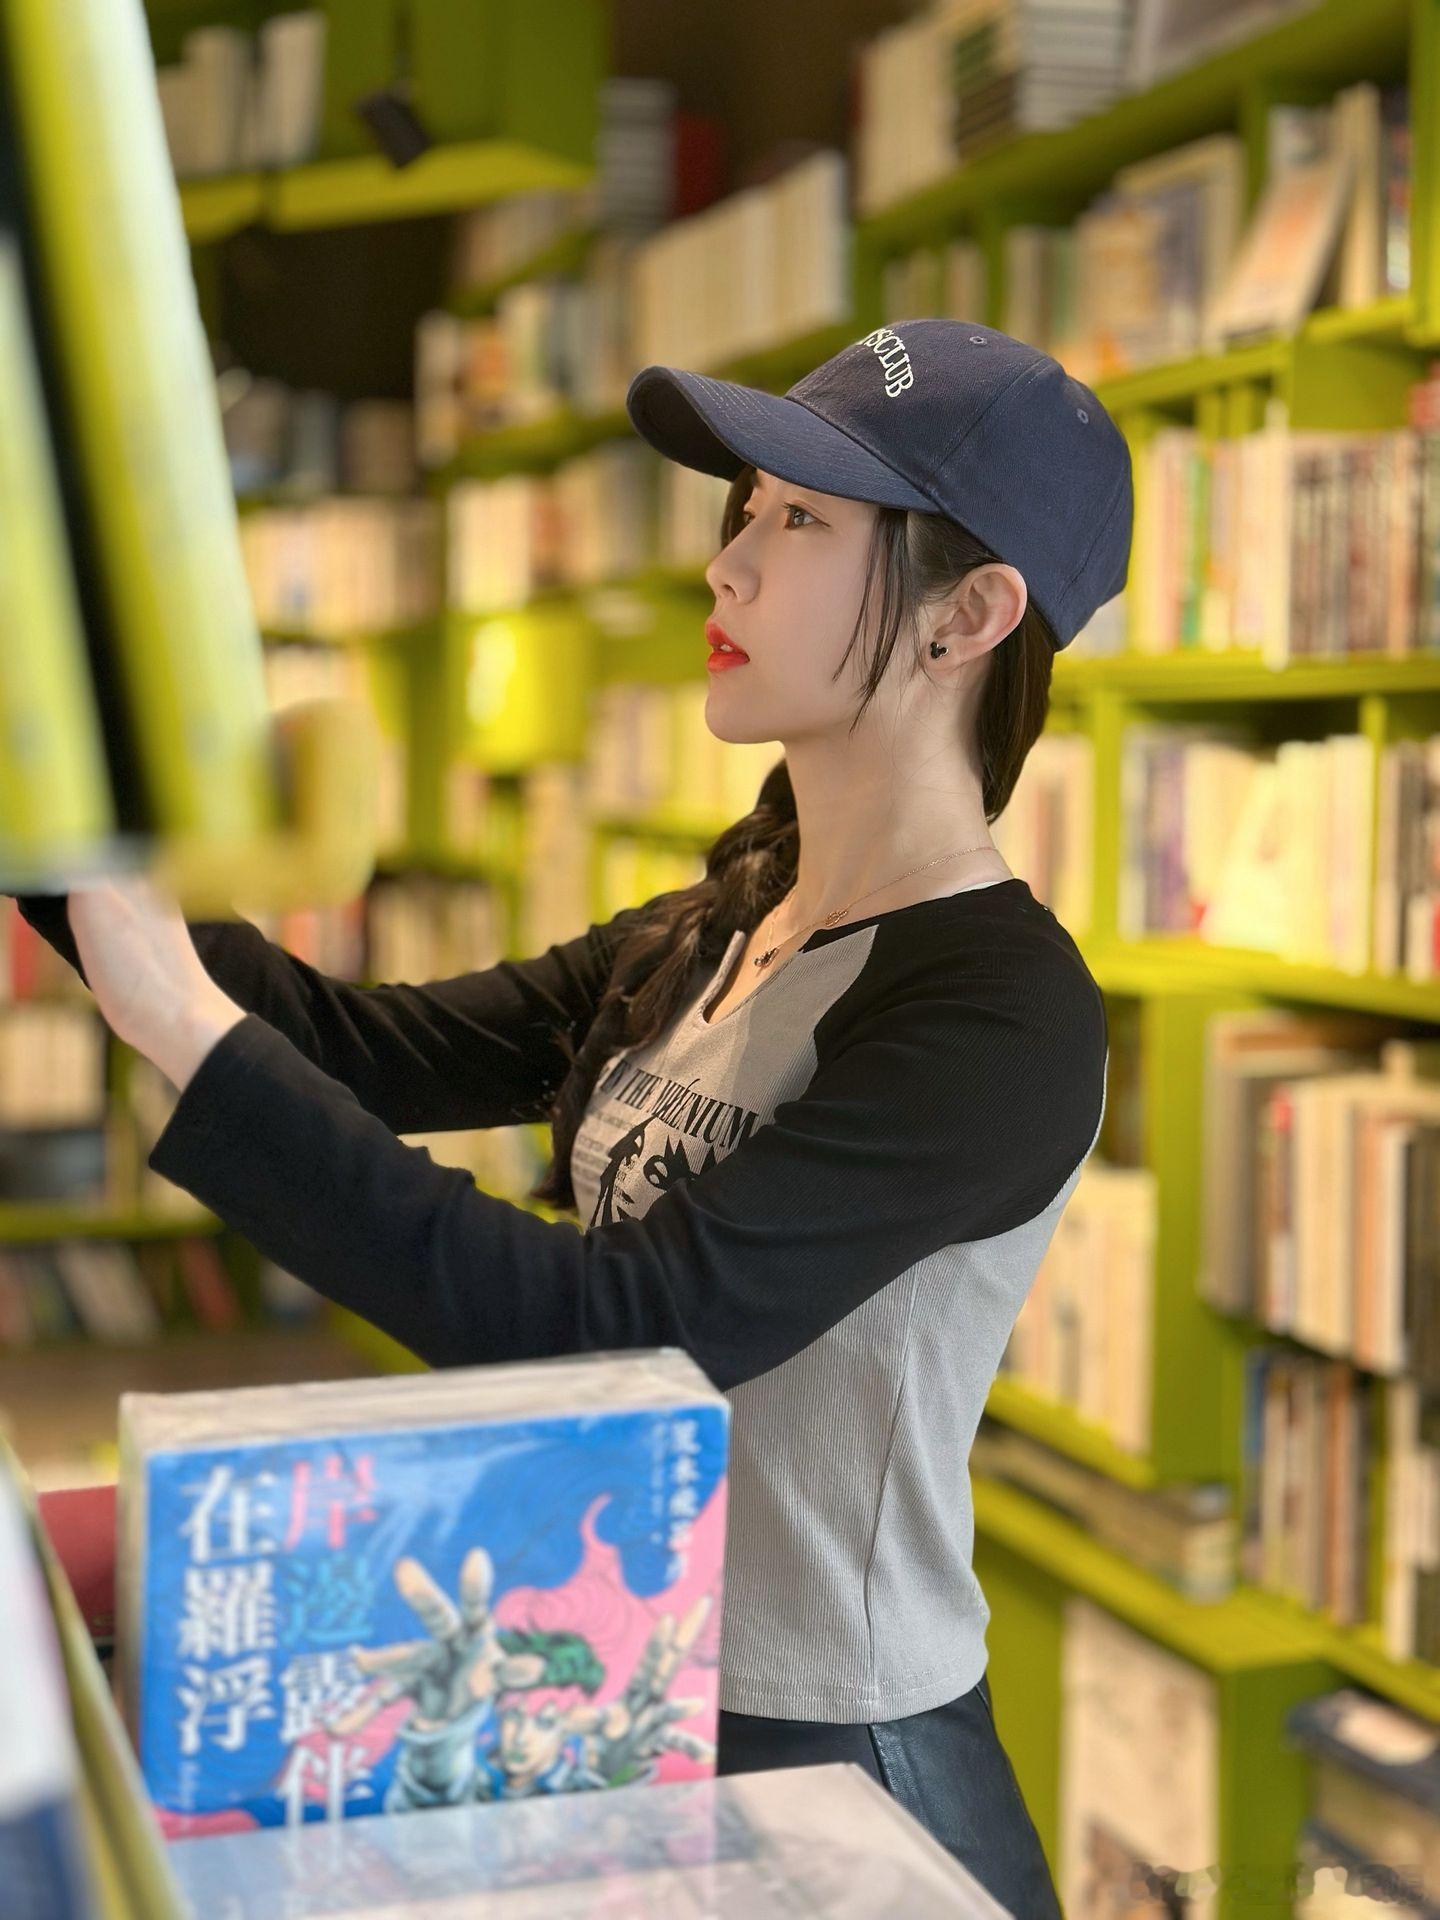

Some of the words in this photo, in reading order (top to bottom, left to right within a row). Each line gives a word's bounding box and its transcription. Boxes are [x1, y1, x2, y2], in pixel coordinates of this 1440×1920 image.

[615, 1067, 663, 1111] THE
[177, 1465, 278, 1757] 在羅浮
